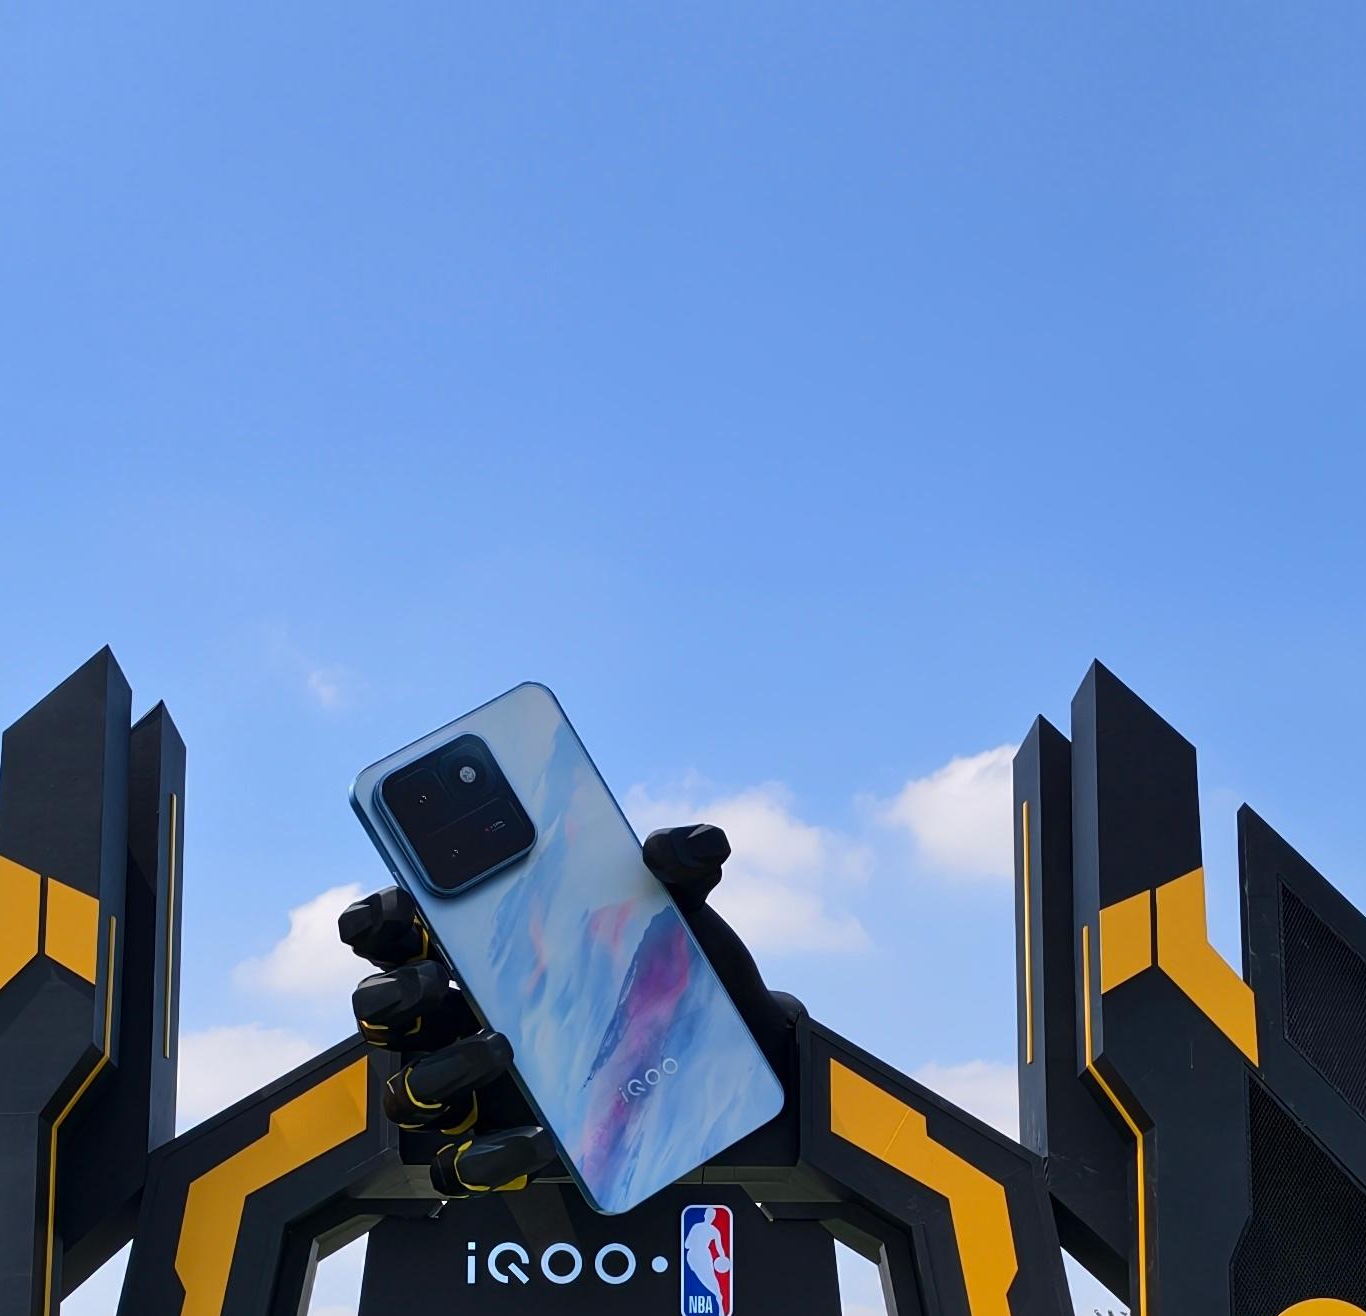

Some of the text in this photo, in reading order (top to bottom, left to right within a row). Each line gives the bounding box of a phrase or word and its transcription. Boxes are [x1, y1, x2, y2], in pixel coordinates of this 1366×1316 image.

[618, 1057, 679, 1104] iQOO
[467, 1242, 636, 1285] iQOO
[688, 1296, 714, 1315] NBA
